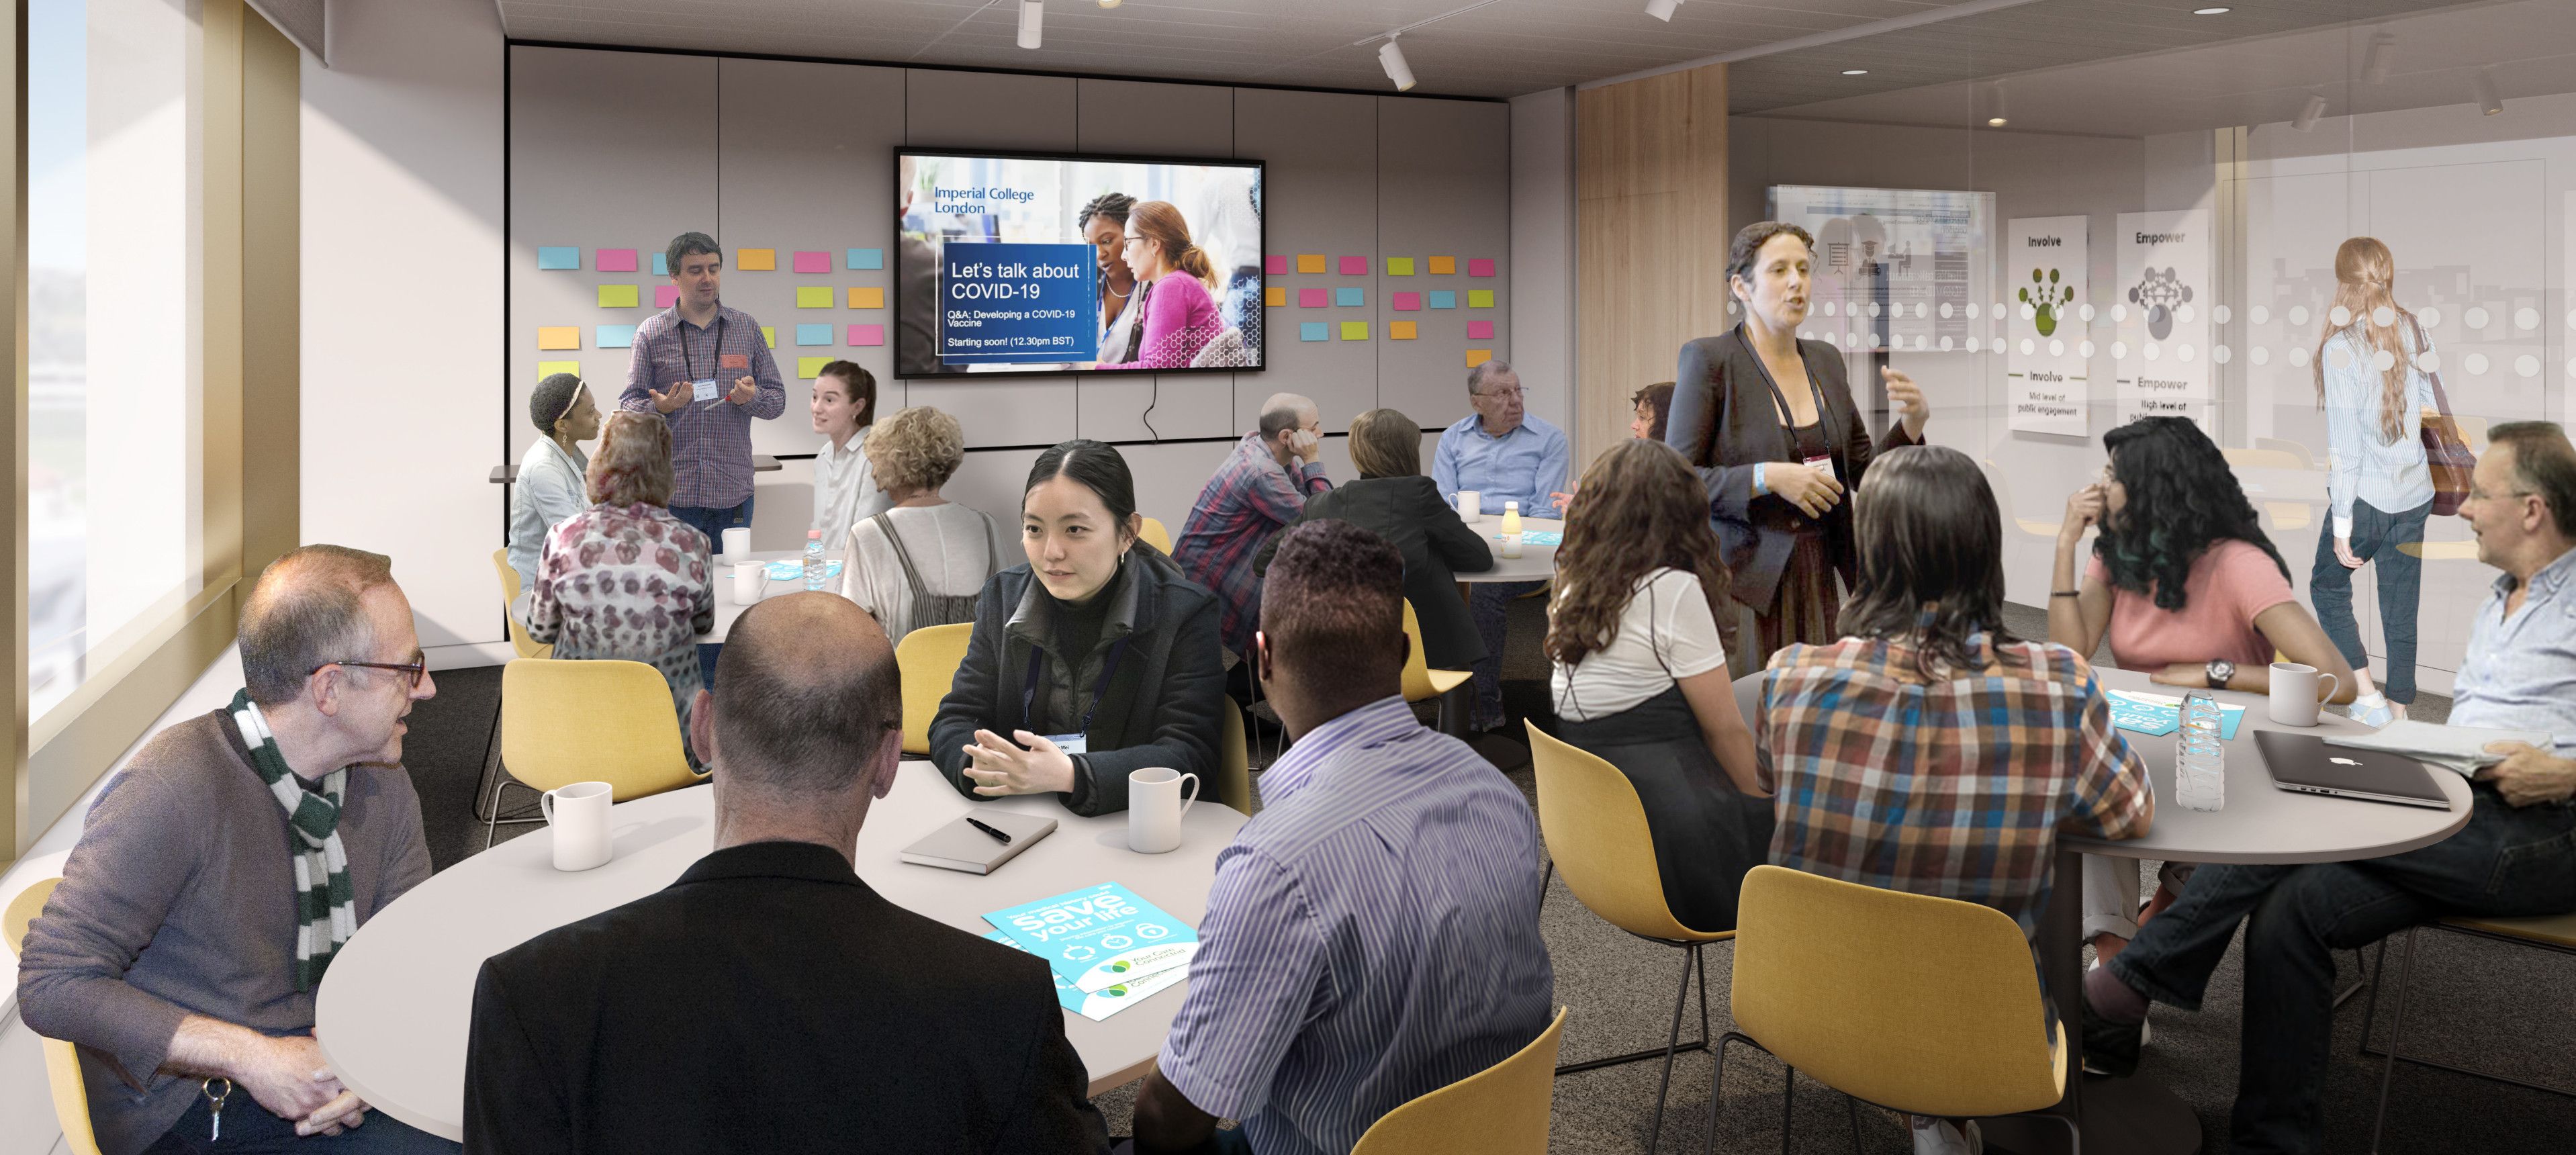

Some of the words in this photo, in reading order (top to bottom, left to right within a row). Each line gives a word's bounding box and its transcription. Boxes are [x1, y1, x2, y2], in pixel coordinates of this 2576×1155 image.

[935, 187, 985, 201] Imperial
[989, 188, 1034, 203] College
[935, 201, 985, 214] London
[2028, 235, 2062, 248] Involve
[2135, 232, 2186, 246] Empower
[952, 263, 993, 278] Let’s
[997, 263, 1027, 279] talk
[1032, 263, 1080, 279] about
[952, 283, 1040, 299] COVID-19
[948, 310, 971, 320] Q&A:
[974, 310, 1022, 321] Developing
[1031, 310, 1075, 318] COVID-19
[948, 319, 982, 328] Vaccine
[948, 338, 982, 348] Starting
[984, 338, 1007, 346] soon!
[1010, 336, 1050, 347] (12.30pm
[1052, 336, 1074, 346] BST)
[2030, 371, 2063, 381] Involve
[2138, 377, 2188, 391] Empower
[2029, 392, 2041, 400] Mid
[2042, 393, 2057, 401] level
[2058, 394, 2066, 402] of
[2018, 404, 2036, 413] public
[2037, 406, 2077, 416] engagement
[2142, 400, 2157, 411] High
[2178, 402, 2187, 411] of
[1012, 894, 1127, 931] save
[1027, 903, 1060, 915] medical
[1029, 917, 1093, 942] your
[1093, 906, 1139, 921] life
[1130, 954, 1152, 962] Your
[1152, 948, 1175, 956] Care
[1136, 949, 1187, 966] Connected
